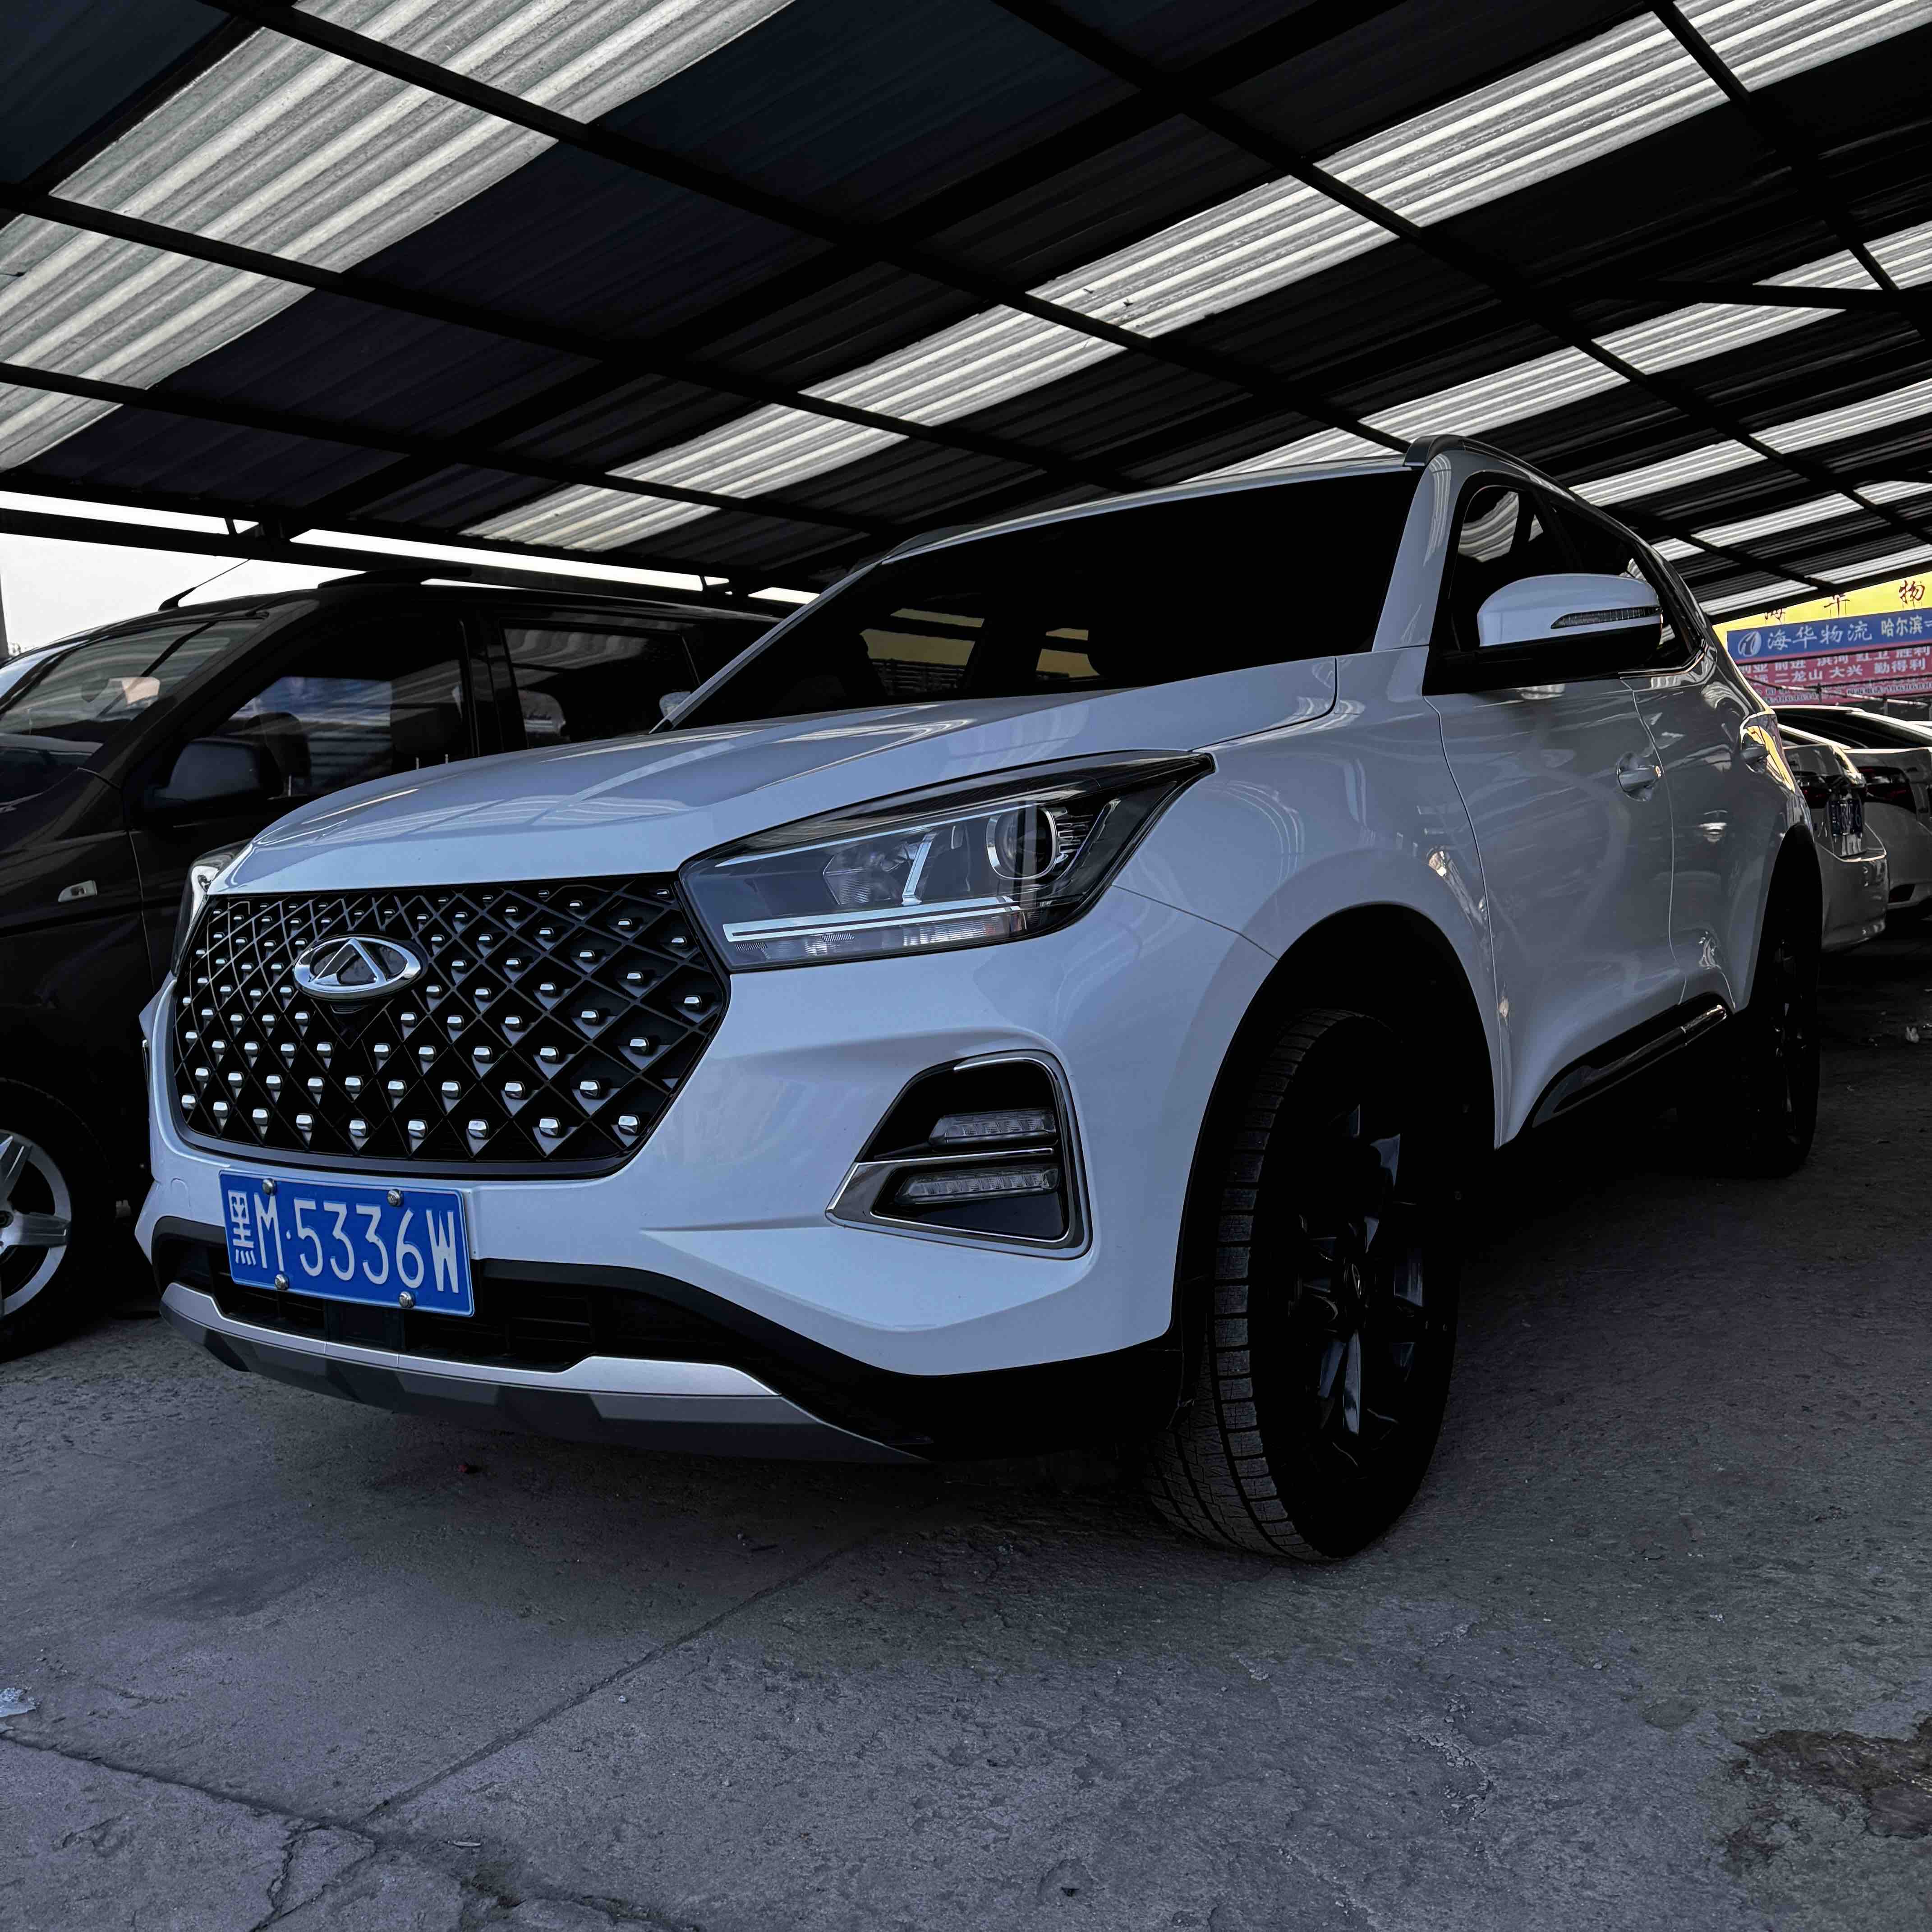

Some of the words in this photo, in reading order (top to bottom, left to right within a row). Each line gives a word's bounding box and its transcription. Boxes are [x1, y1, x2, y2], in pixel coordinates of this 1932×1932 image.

[1767, 620, 1872, 650] 海华物流
[1881, 614, 1923, 638] 哈尔滨
[1775, 668, 1823, 683] 二龙山
[1829, 664, 1863, 678] 大兴
